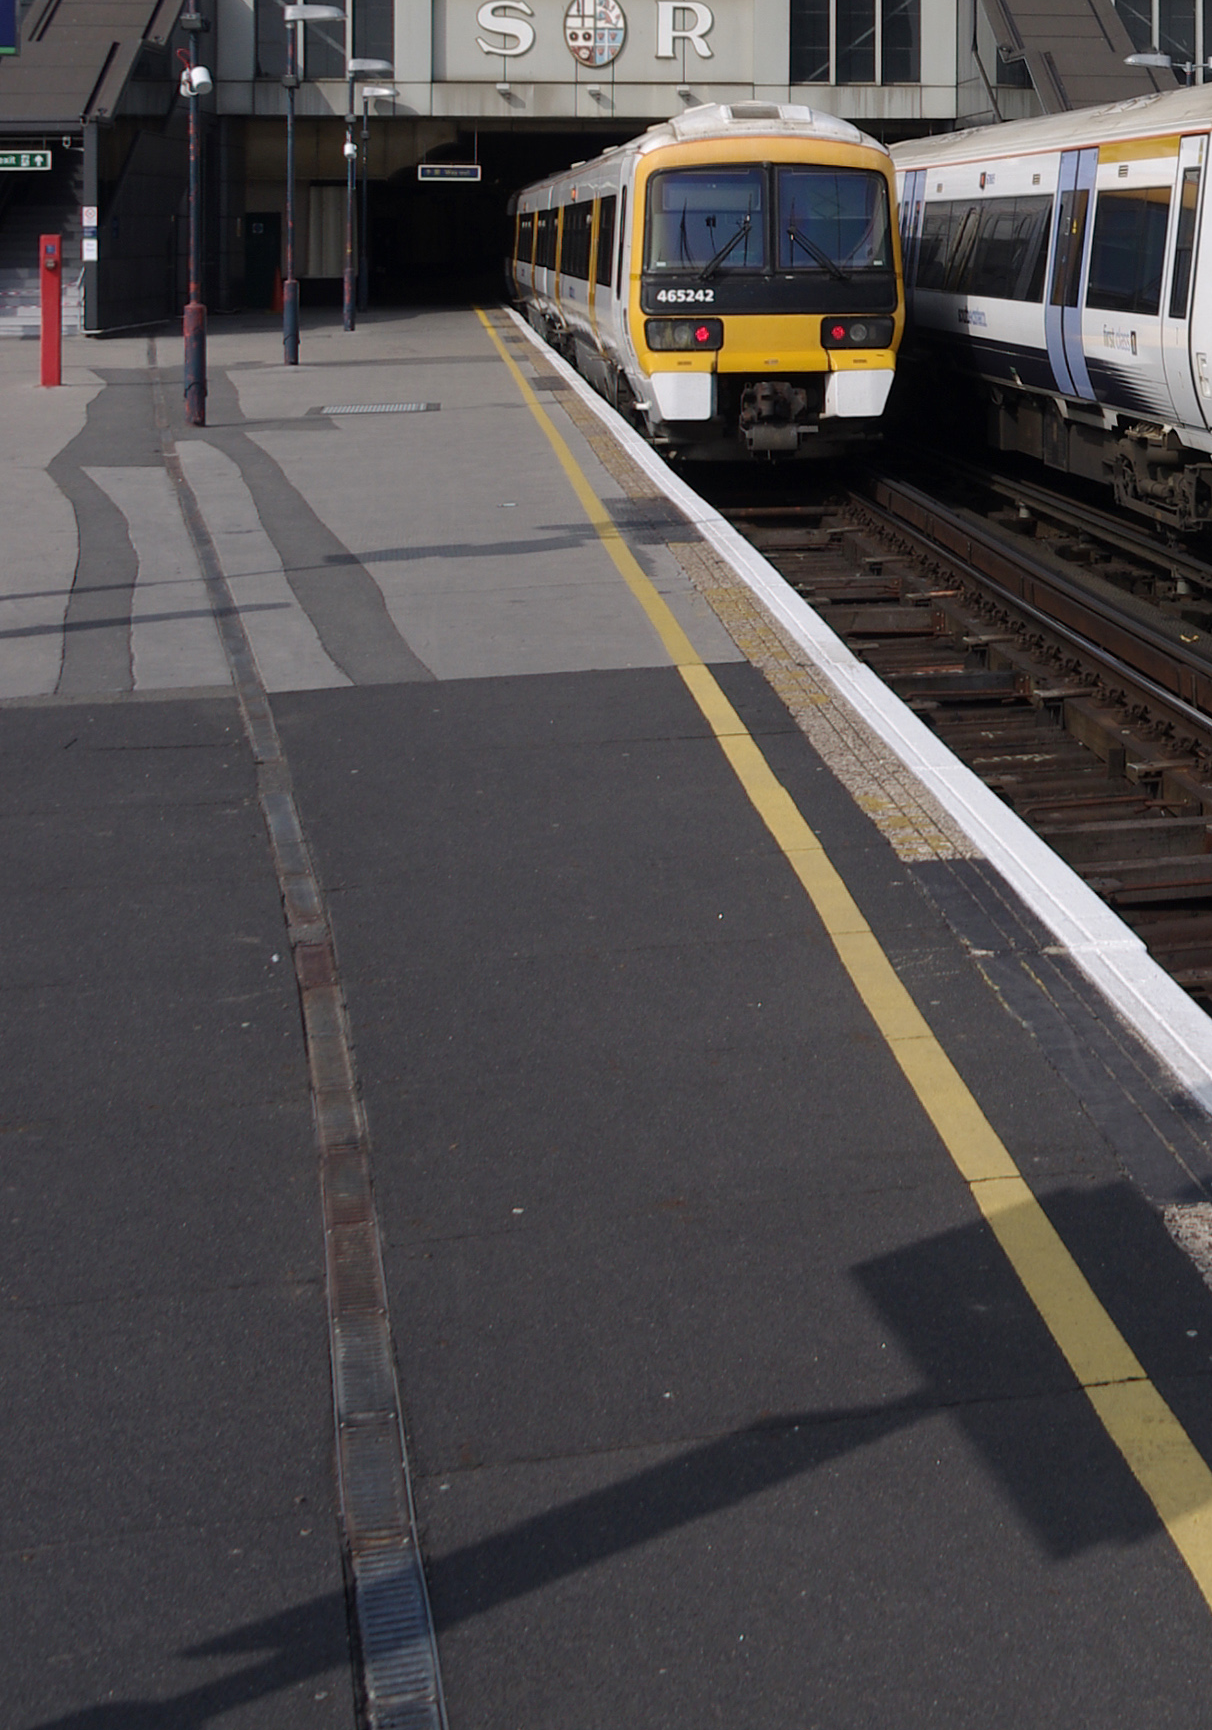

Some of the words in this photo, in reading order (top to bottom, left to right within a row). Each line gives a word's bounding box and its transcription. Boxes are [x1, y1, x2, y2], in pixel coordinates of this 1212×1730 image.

[475, 0, 535, 57] S
[655, 0, 714, 59] R
[656, 289, 715, 303] 465242
